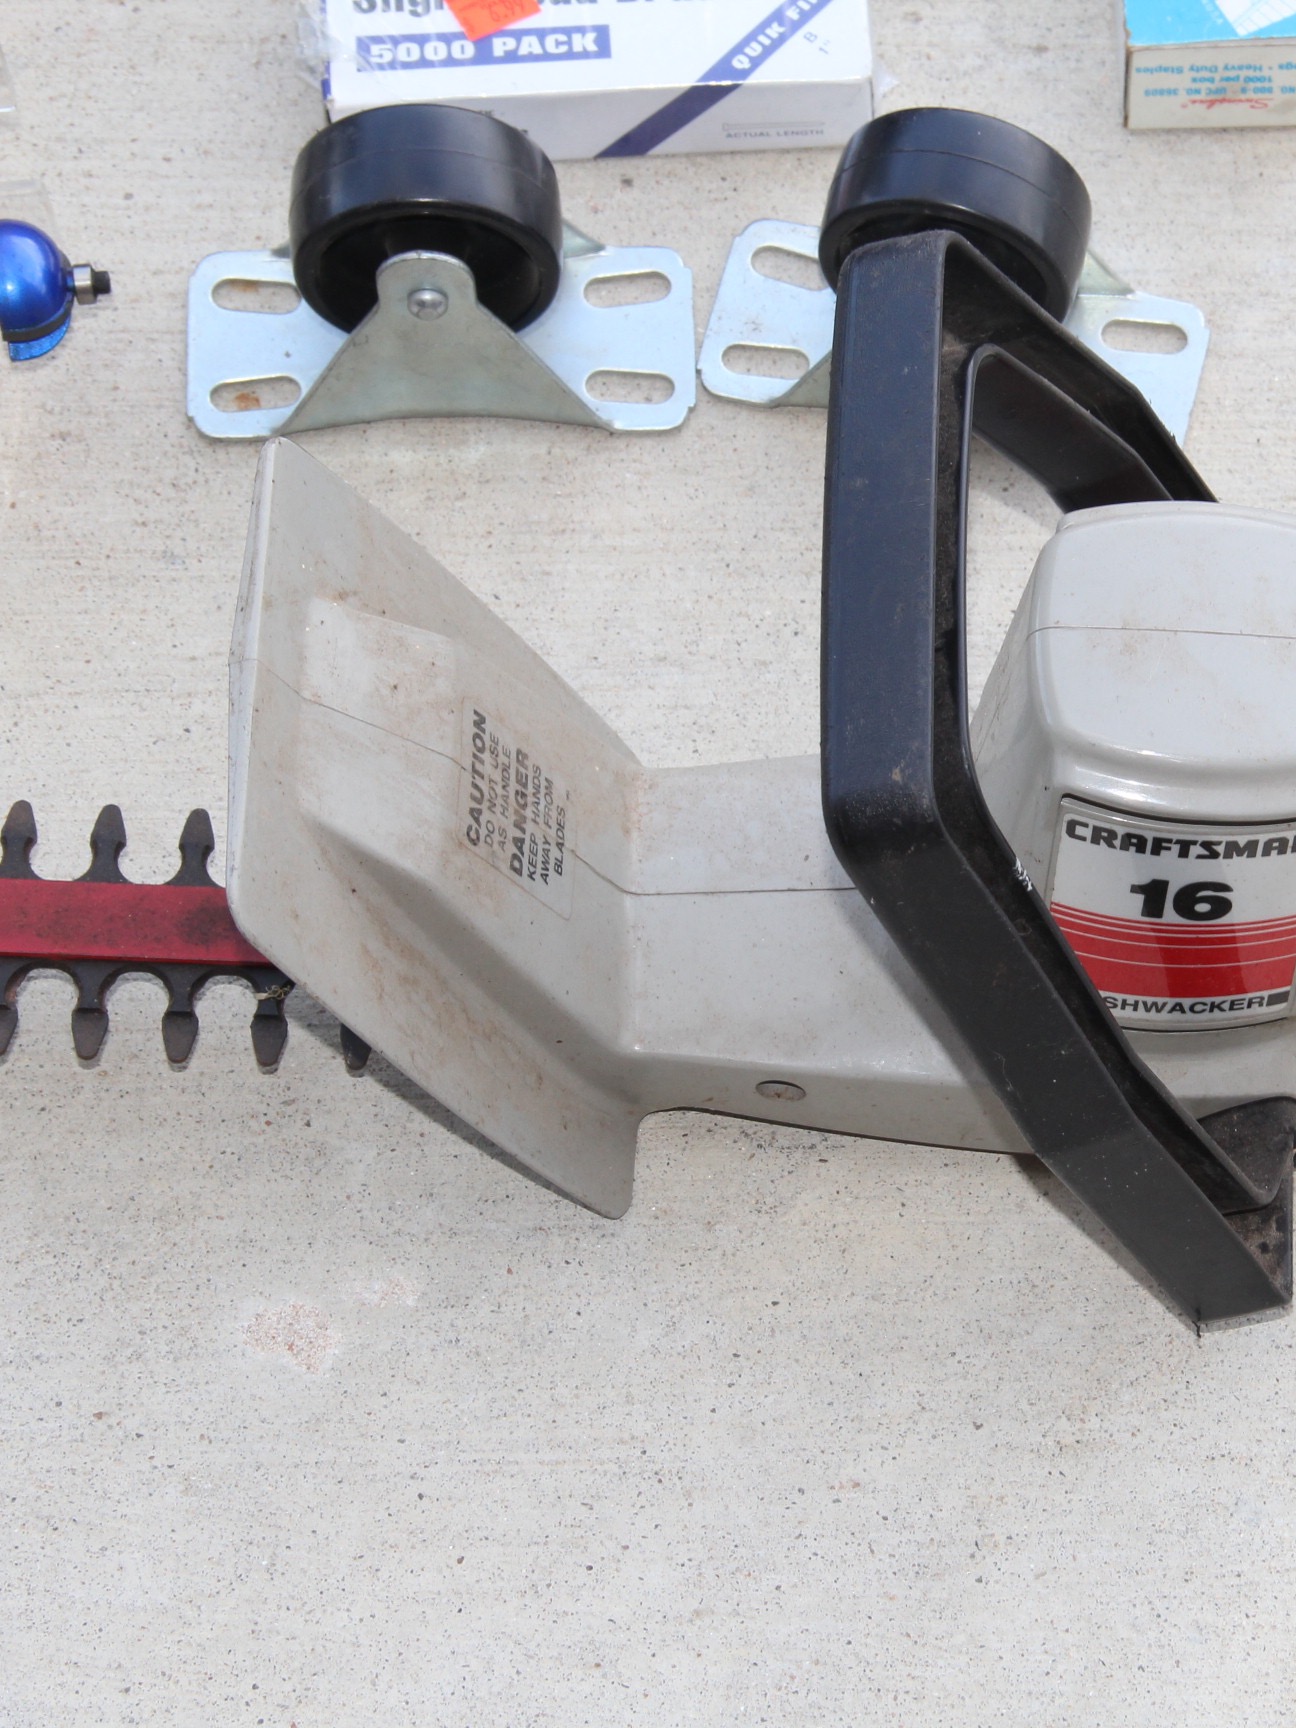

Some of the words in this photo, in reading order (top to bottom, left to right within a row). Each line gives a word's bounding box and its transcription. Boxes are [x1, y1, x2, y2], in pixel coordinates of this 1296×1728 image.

[370, 40, 476, 63] 5000
[492, 32, 599, 57] PACK
[731, 21, 786, 70] QUIK
[785, 0, 818, 21] FI
[1135, 63, 1183, 75] Staples
[1188, 63, 1218, 74] Duty
[1191, 75, 1215, 84] box
[1219, 74, 1240, 84] per
[1222, 62, 1263, 74] Heavy
[1243, 75, 1274, 84] 1000
[1205, 87, 1228, 96] UPC
[725, 130, 770, 139] ACTUAL
[776, 129, 825, 138] LENGTH
[489, 731, 500, 770] USE
[466, 709, 487, 847] CAUTION
[486, 774, 498, 815] NOT
[499, 744, 512, 819] HANDLE
[530, 763, 542, 826] HANDS
[509, 747, 530, 878] DANGER
[543, 776, 554, 830] FROM
[484, 819, 496, 849] DO
[497, 825, 508, 854] AS
[553, 804, 567, 878] BLADES
[527, 832, 539, 882] KEEP
[539, 834, 553, 886] AWAY
[1129, 878, 1234, 921] 16
